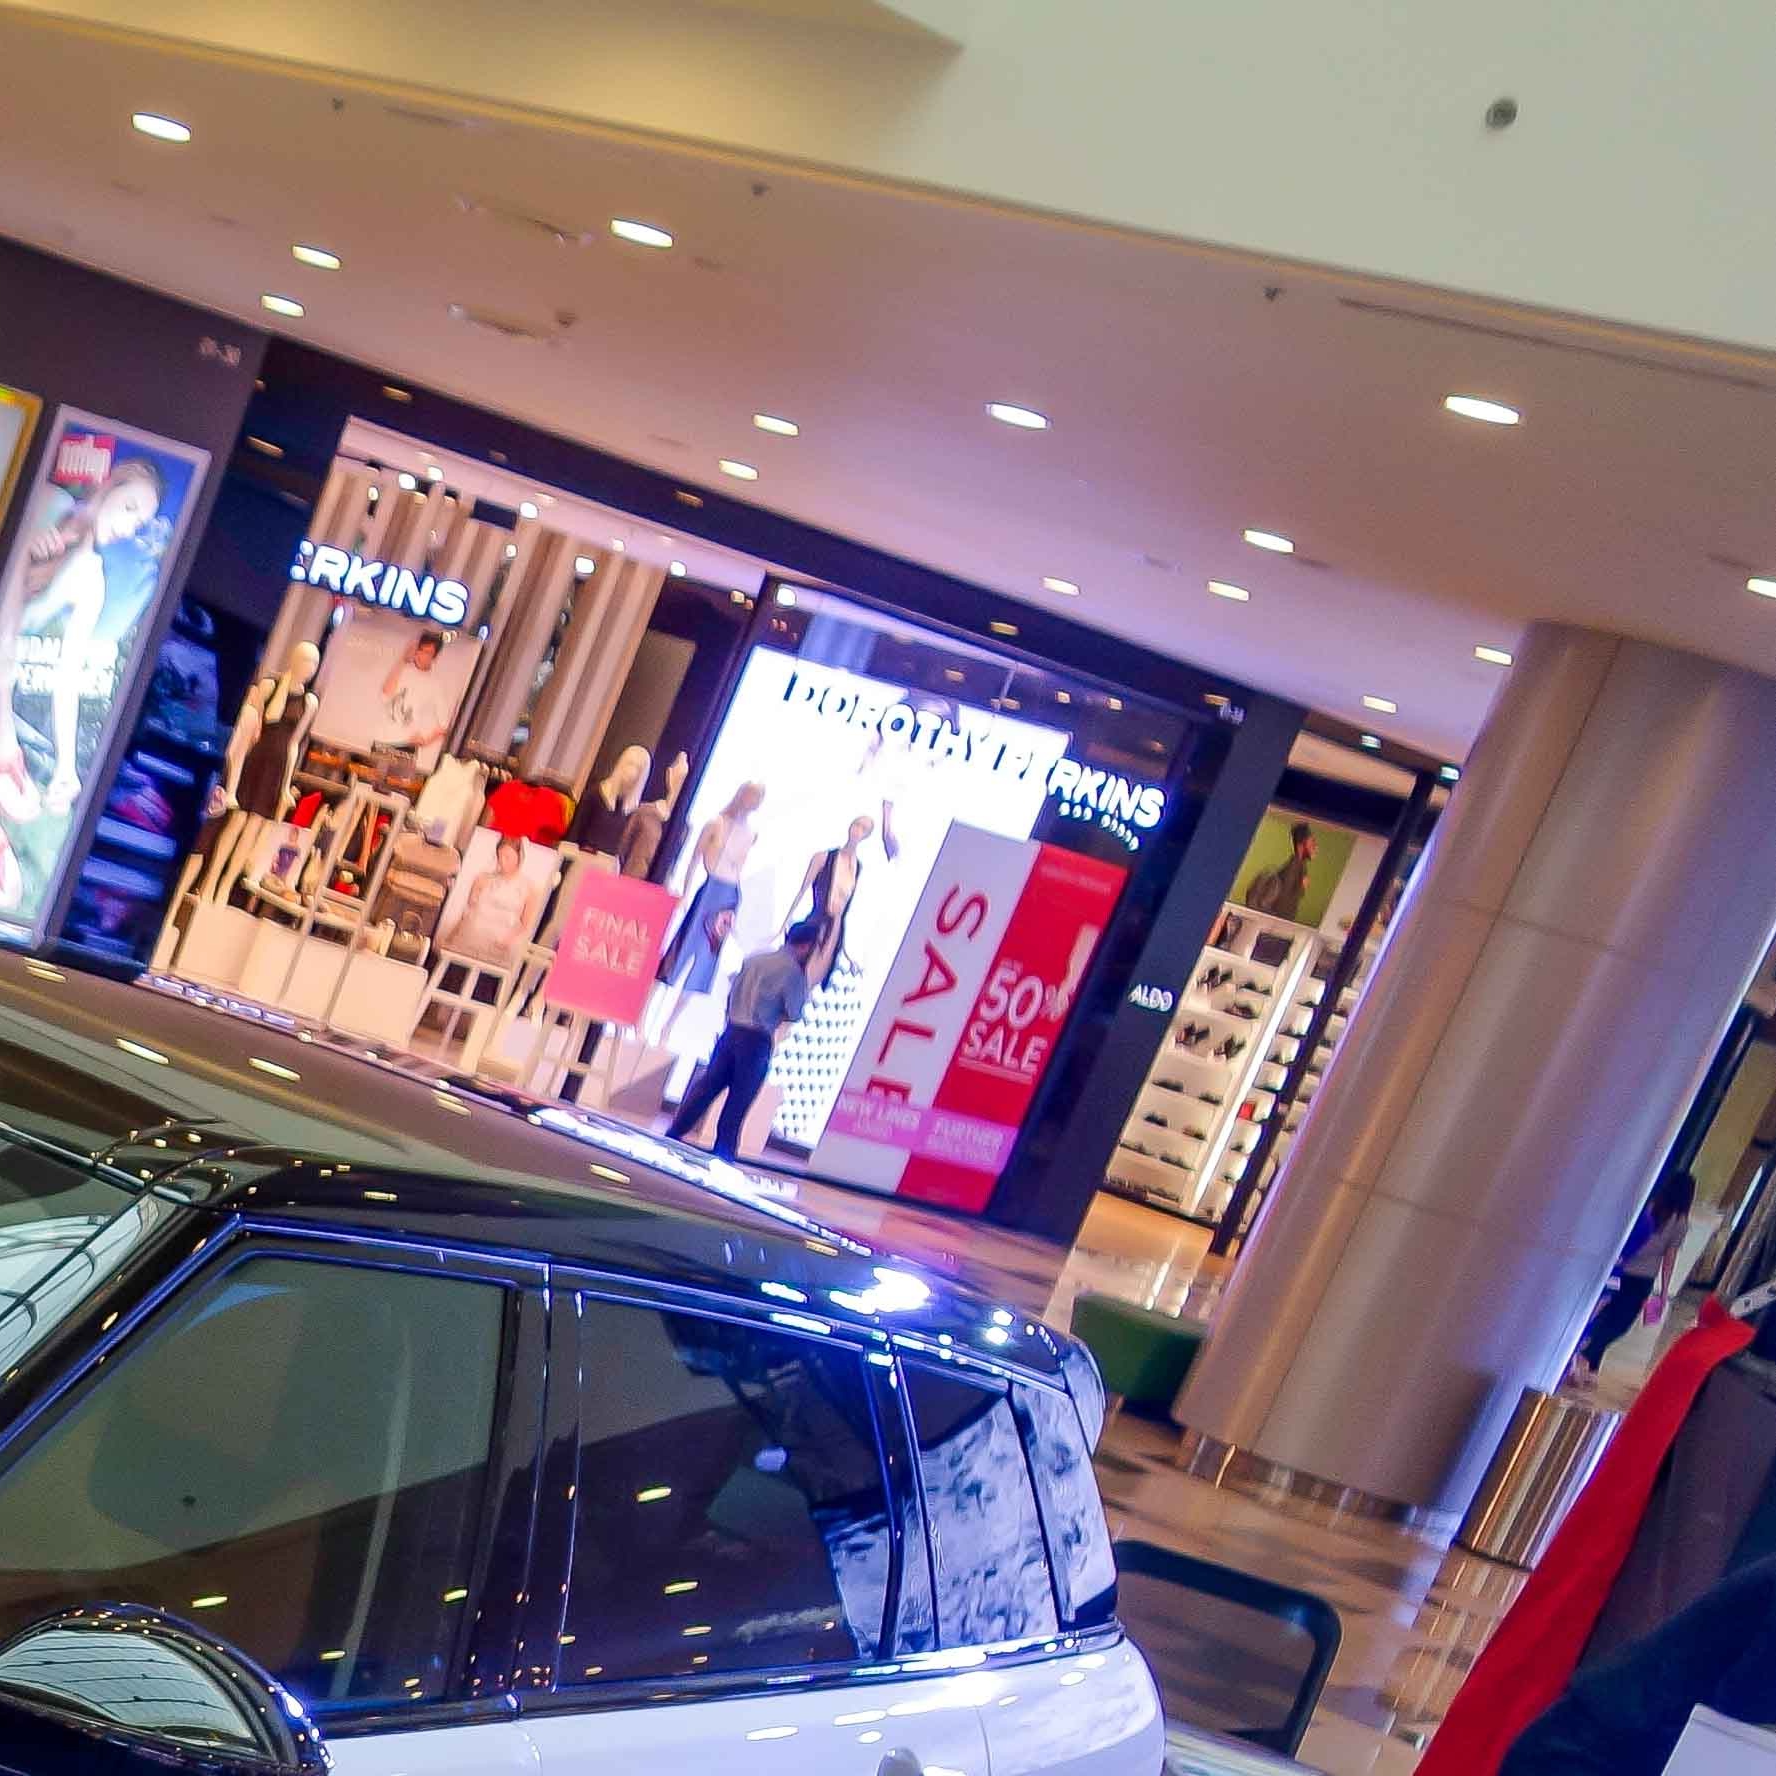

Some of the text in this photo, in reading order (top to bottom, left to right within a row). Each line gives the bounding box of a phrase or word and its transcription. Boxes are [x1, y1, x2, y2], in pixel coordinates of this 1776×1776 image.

[290, 539, 470, 626] RKINS
[992, 740, 1165, 829] PRKINS
[582, 905, 651, 944] FINAL
[573, 934, 644, 978] SALE
[979, 966, 1070, 1031] 50%
[1128, 983, 1174, 1012] ALDO
[963, 1020, 1049, 1074] SALE
